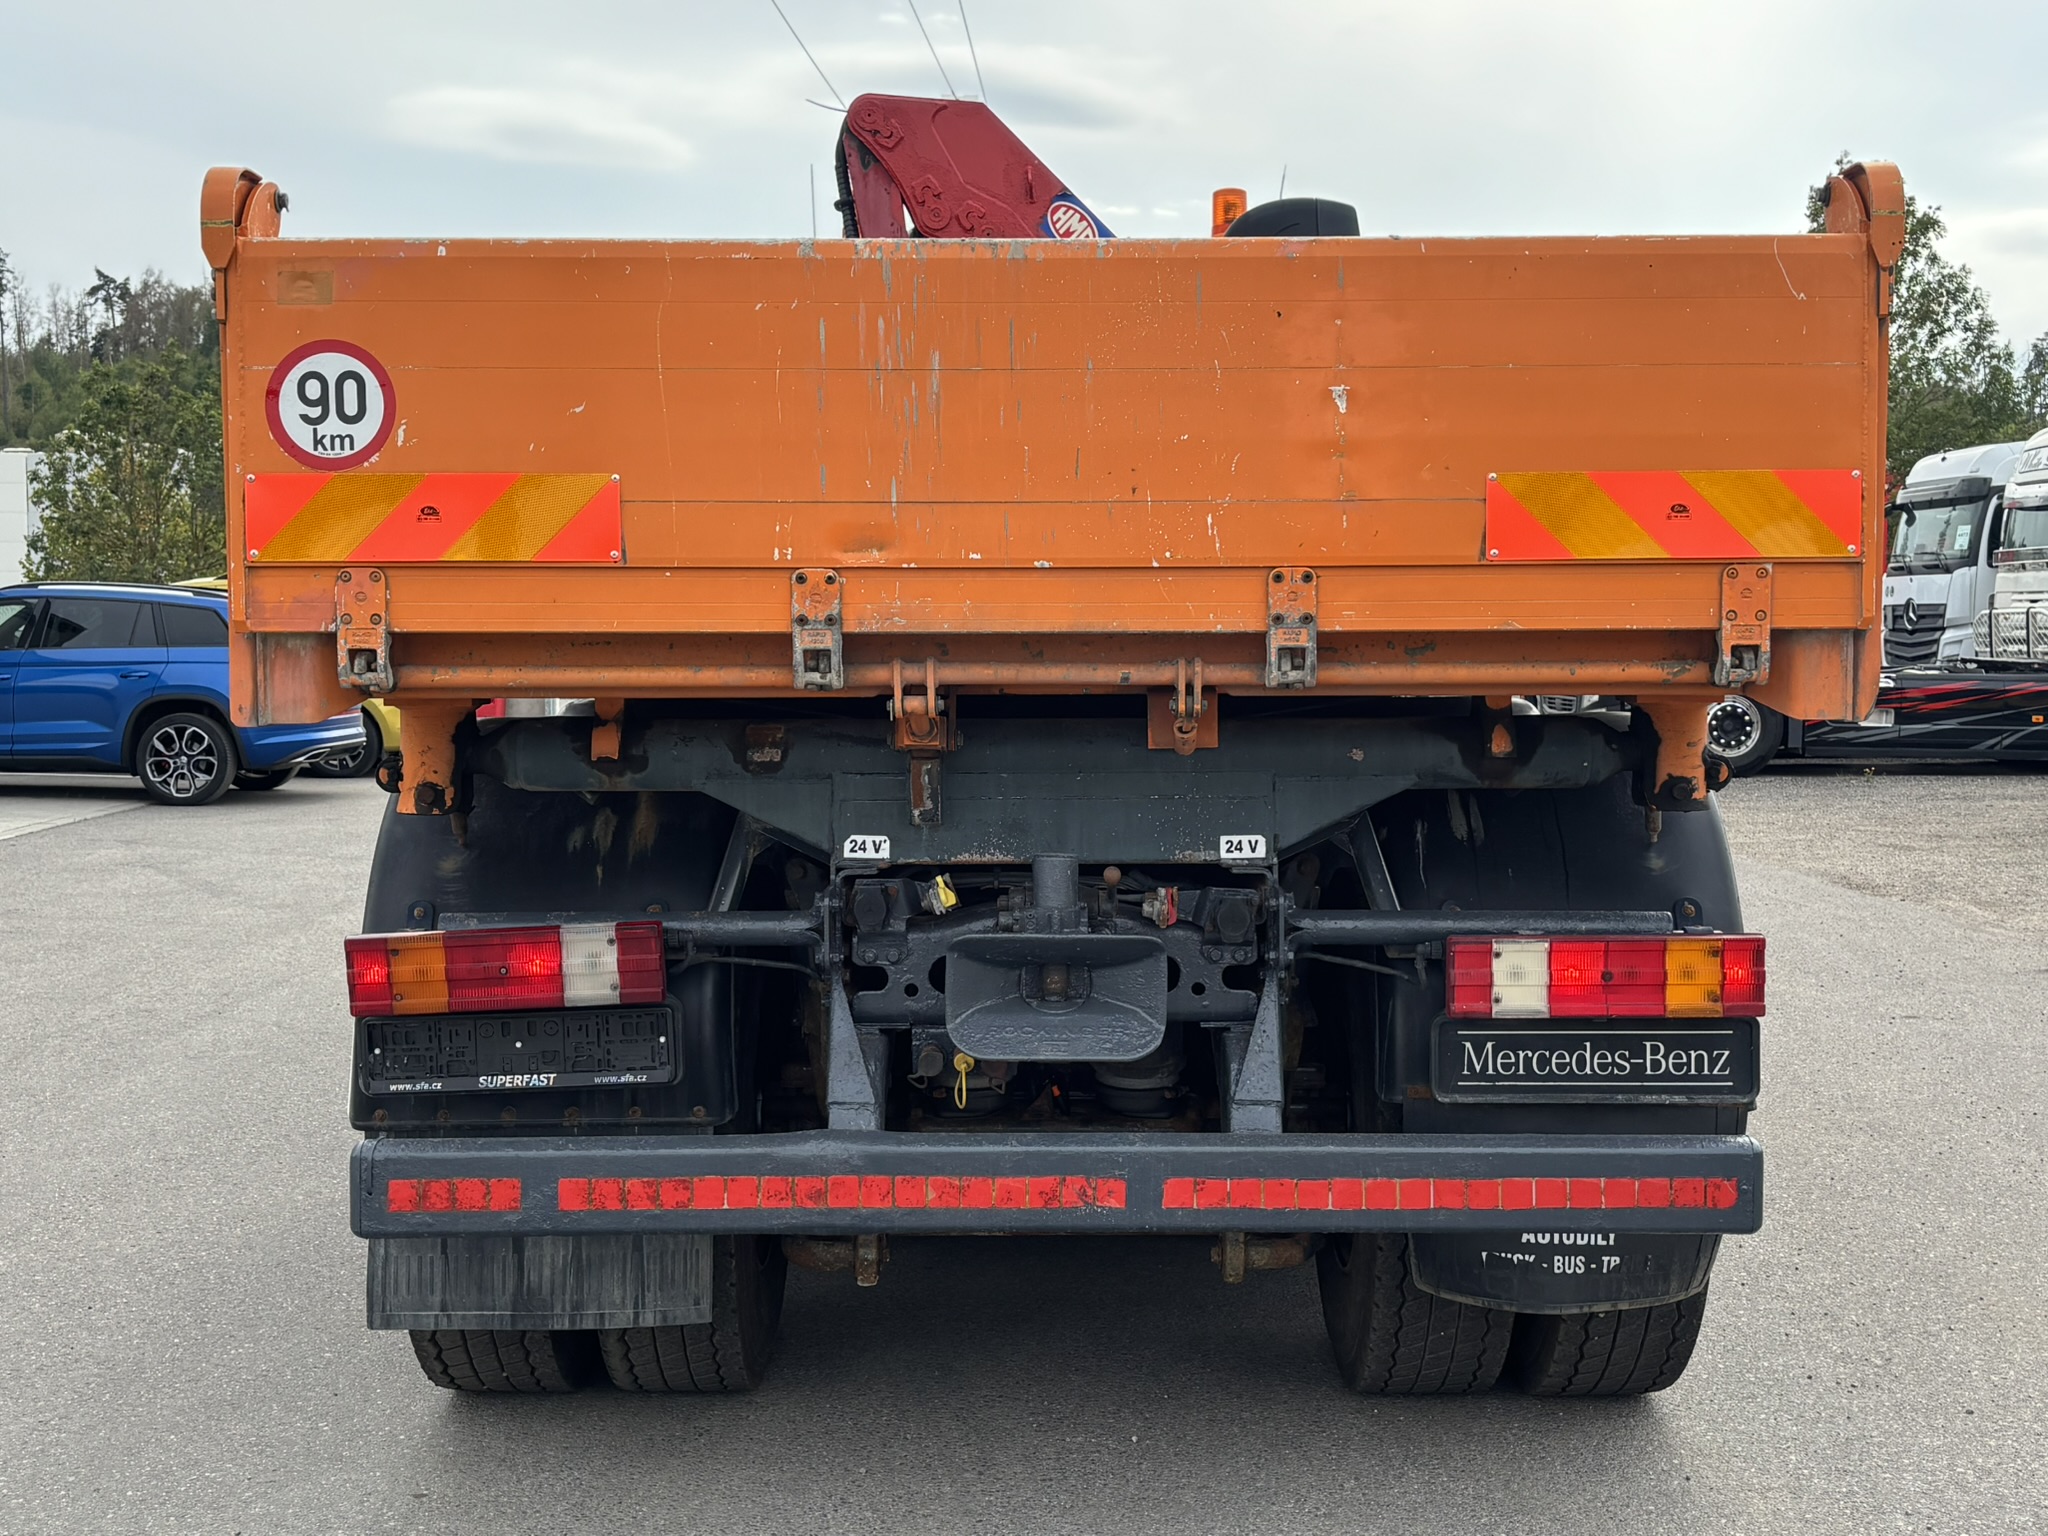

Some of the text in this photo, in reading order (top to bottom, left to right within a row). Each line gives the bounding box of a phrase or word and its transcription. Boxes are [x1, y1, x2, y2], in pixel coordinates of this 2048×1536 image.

[297, 370, 367, 426] 90
[312, 427, 355, 451] km
[849, 839, 867, 854] 24
[1225, 839, 1258, 854] 24 V
[1461, 1041, 1731, 1076] Mercedes-Benz
[478, 1073, 557, 1088] SUPERFAST
[594, 1073, 648, 1084] www.sfa.cz
[389, 1081, 442, 1092] www.sfa.cz
[1553, 1255, 1586, 1274] BUS
